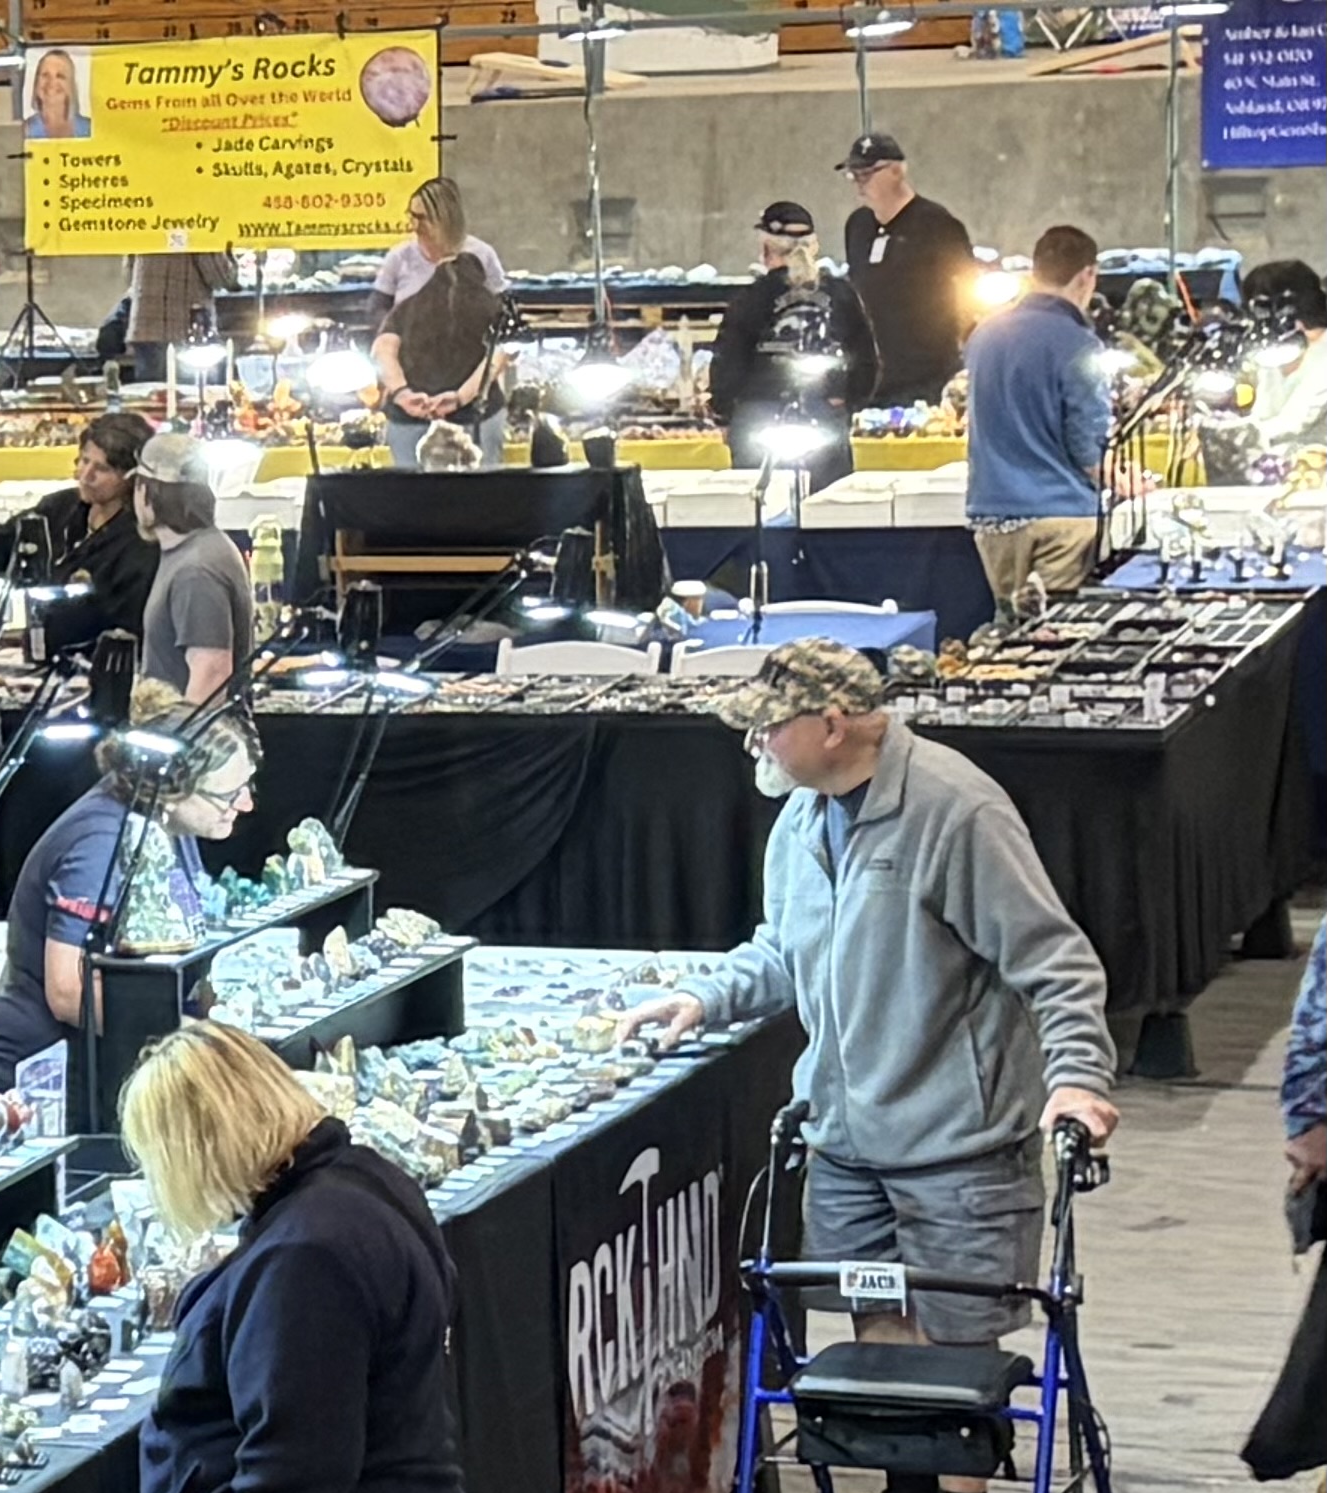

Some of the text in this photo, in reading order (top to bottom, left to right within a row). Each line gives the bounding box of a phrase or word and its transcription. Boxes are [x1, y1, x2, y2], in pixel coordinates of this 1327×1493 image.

[123, 53, 336, 88] Tammy's Rocks
[106, 97, 150, 110] Gems
[156, 95, 196, 109] From
[202, 92, 222, 107] all
[226, 93, 266, 107] Over
[270, 90, 298, 104] the
[212, 135, 334, 153] Jade Carvings
[59, 152, 122, 168] Towers
[212, 157, 414, 180] Skulls, Agates, Crystals
[59, 173, 129, 192] Spheres
[59, 194, 154, 213] Specimens
[59, 213, 220, 232] Gemstone Jewelry
